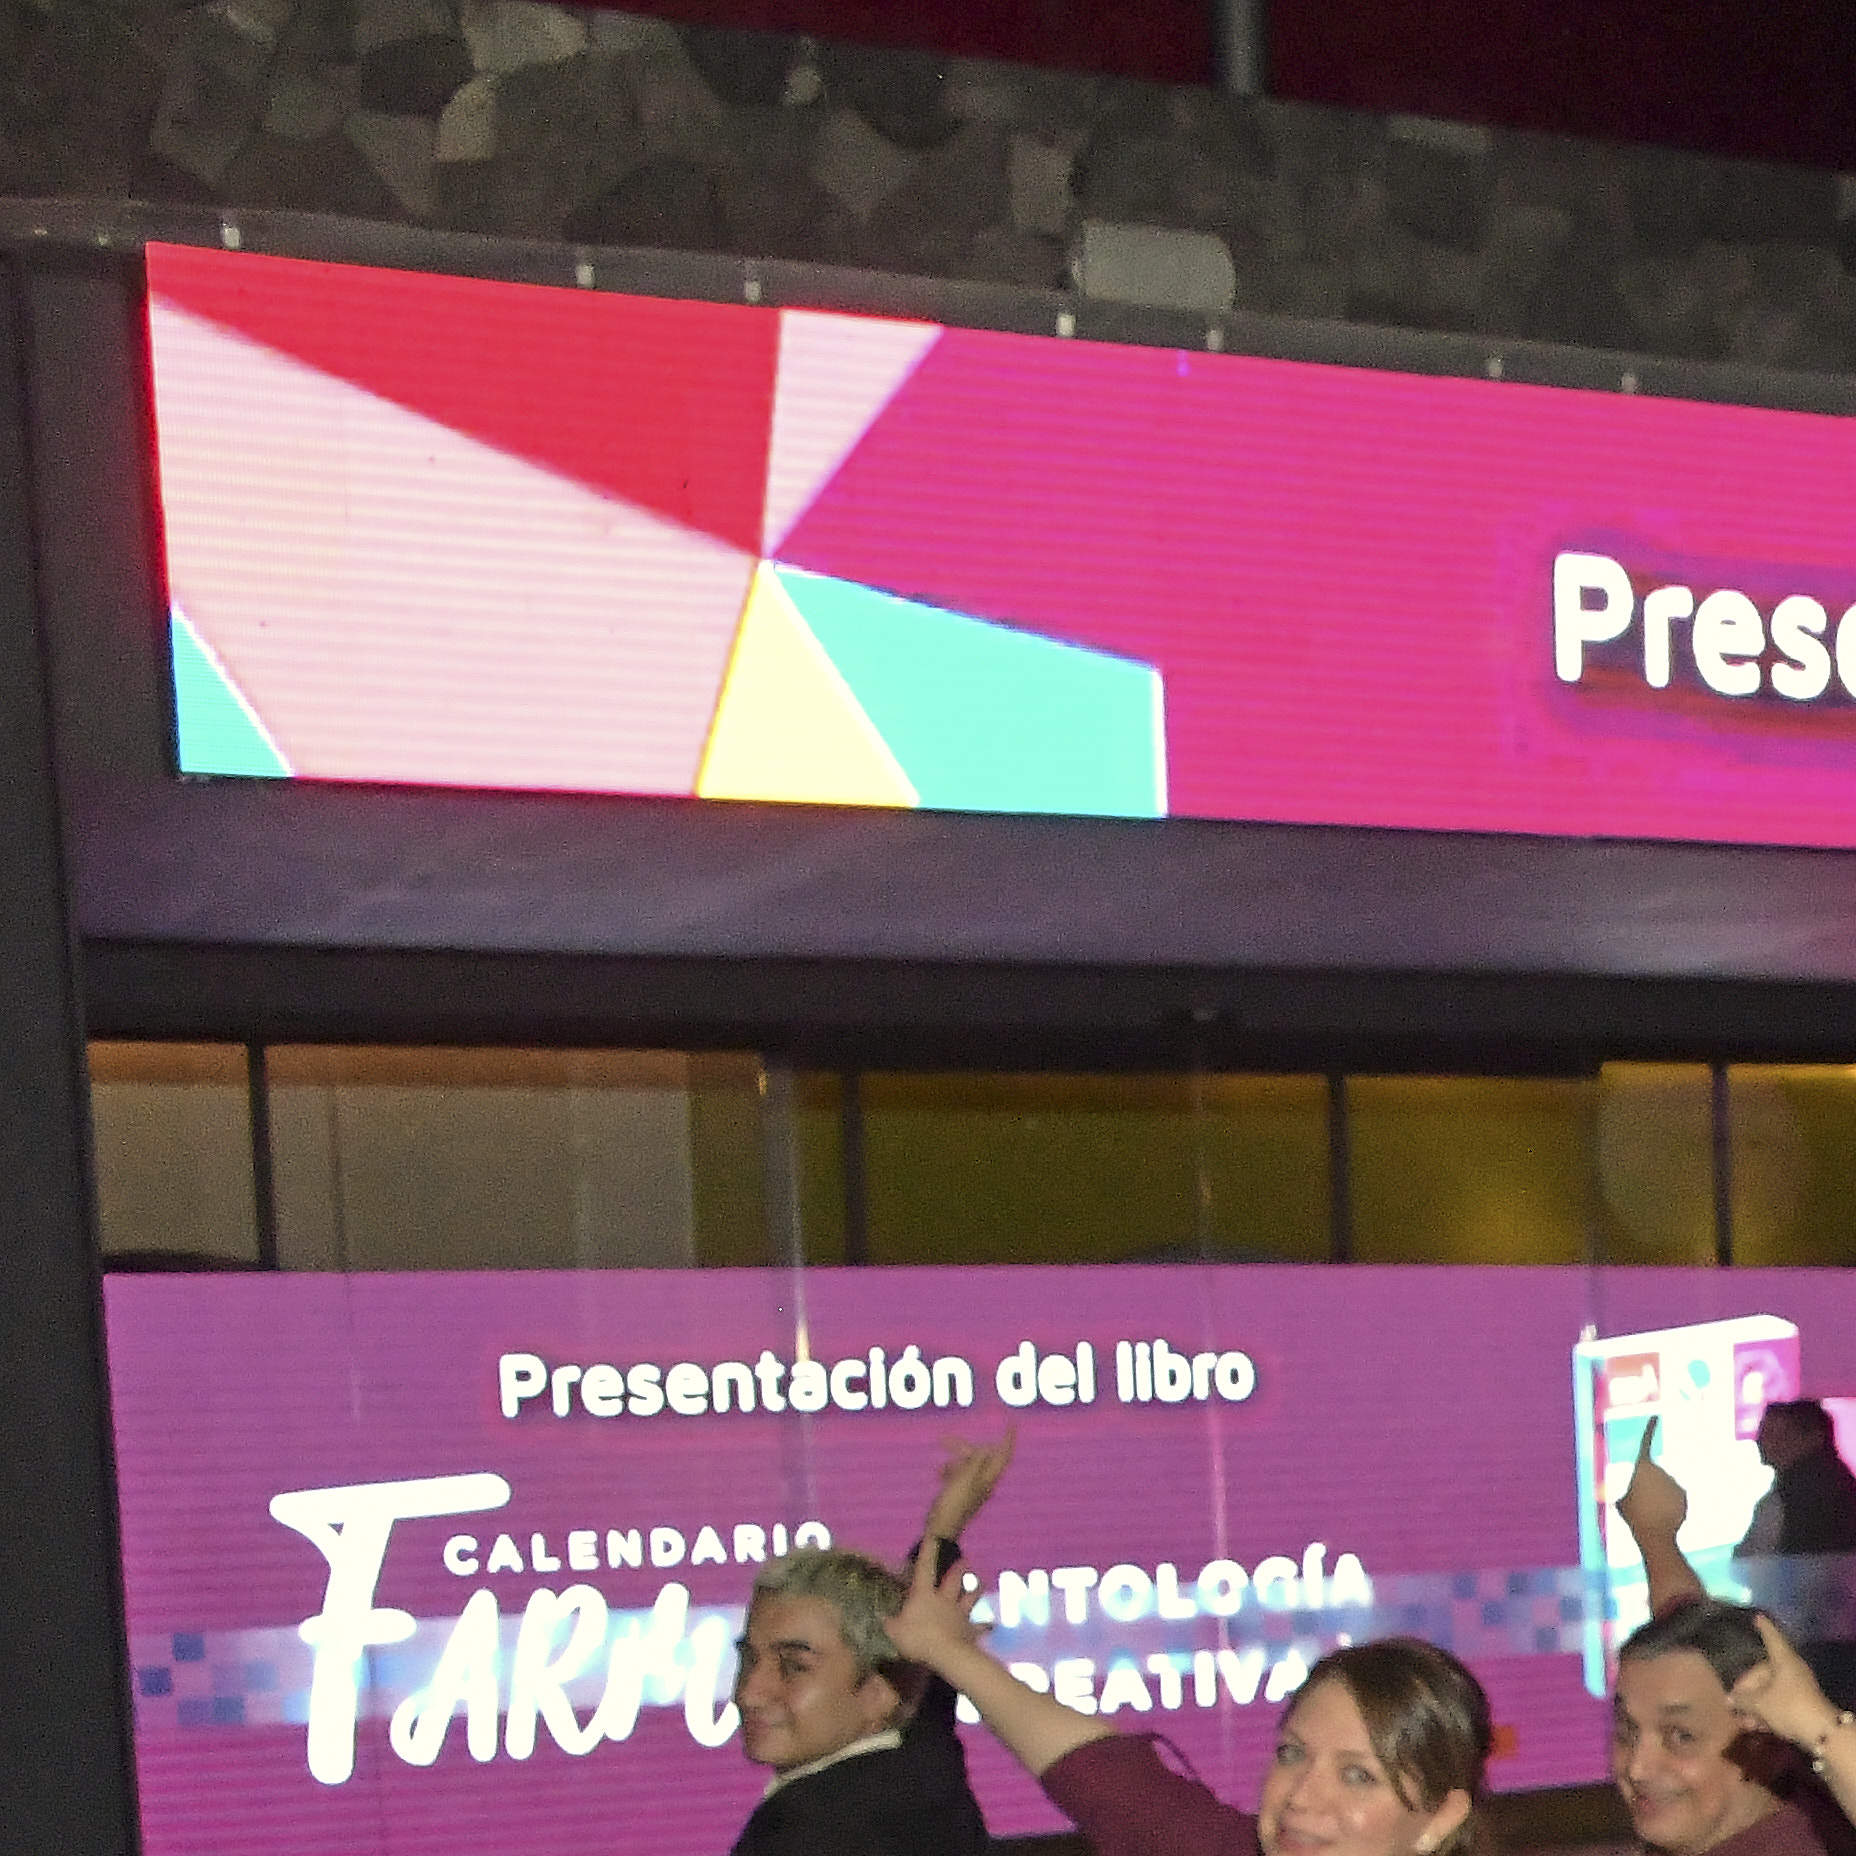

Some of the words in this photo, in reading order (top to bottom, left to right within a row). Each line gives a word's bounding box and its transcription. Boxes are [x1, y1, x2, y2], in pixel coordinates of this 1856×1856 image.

[498, 1345, 974, 1419] Presentación
[994, 1340, 1096, 1408] del
[1115, 1337, 1256, 1404] libro
[442, 1520, 833, 1577] CALENDARIO
[267, 1471, 742, 1786] FARM
